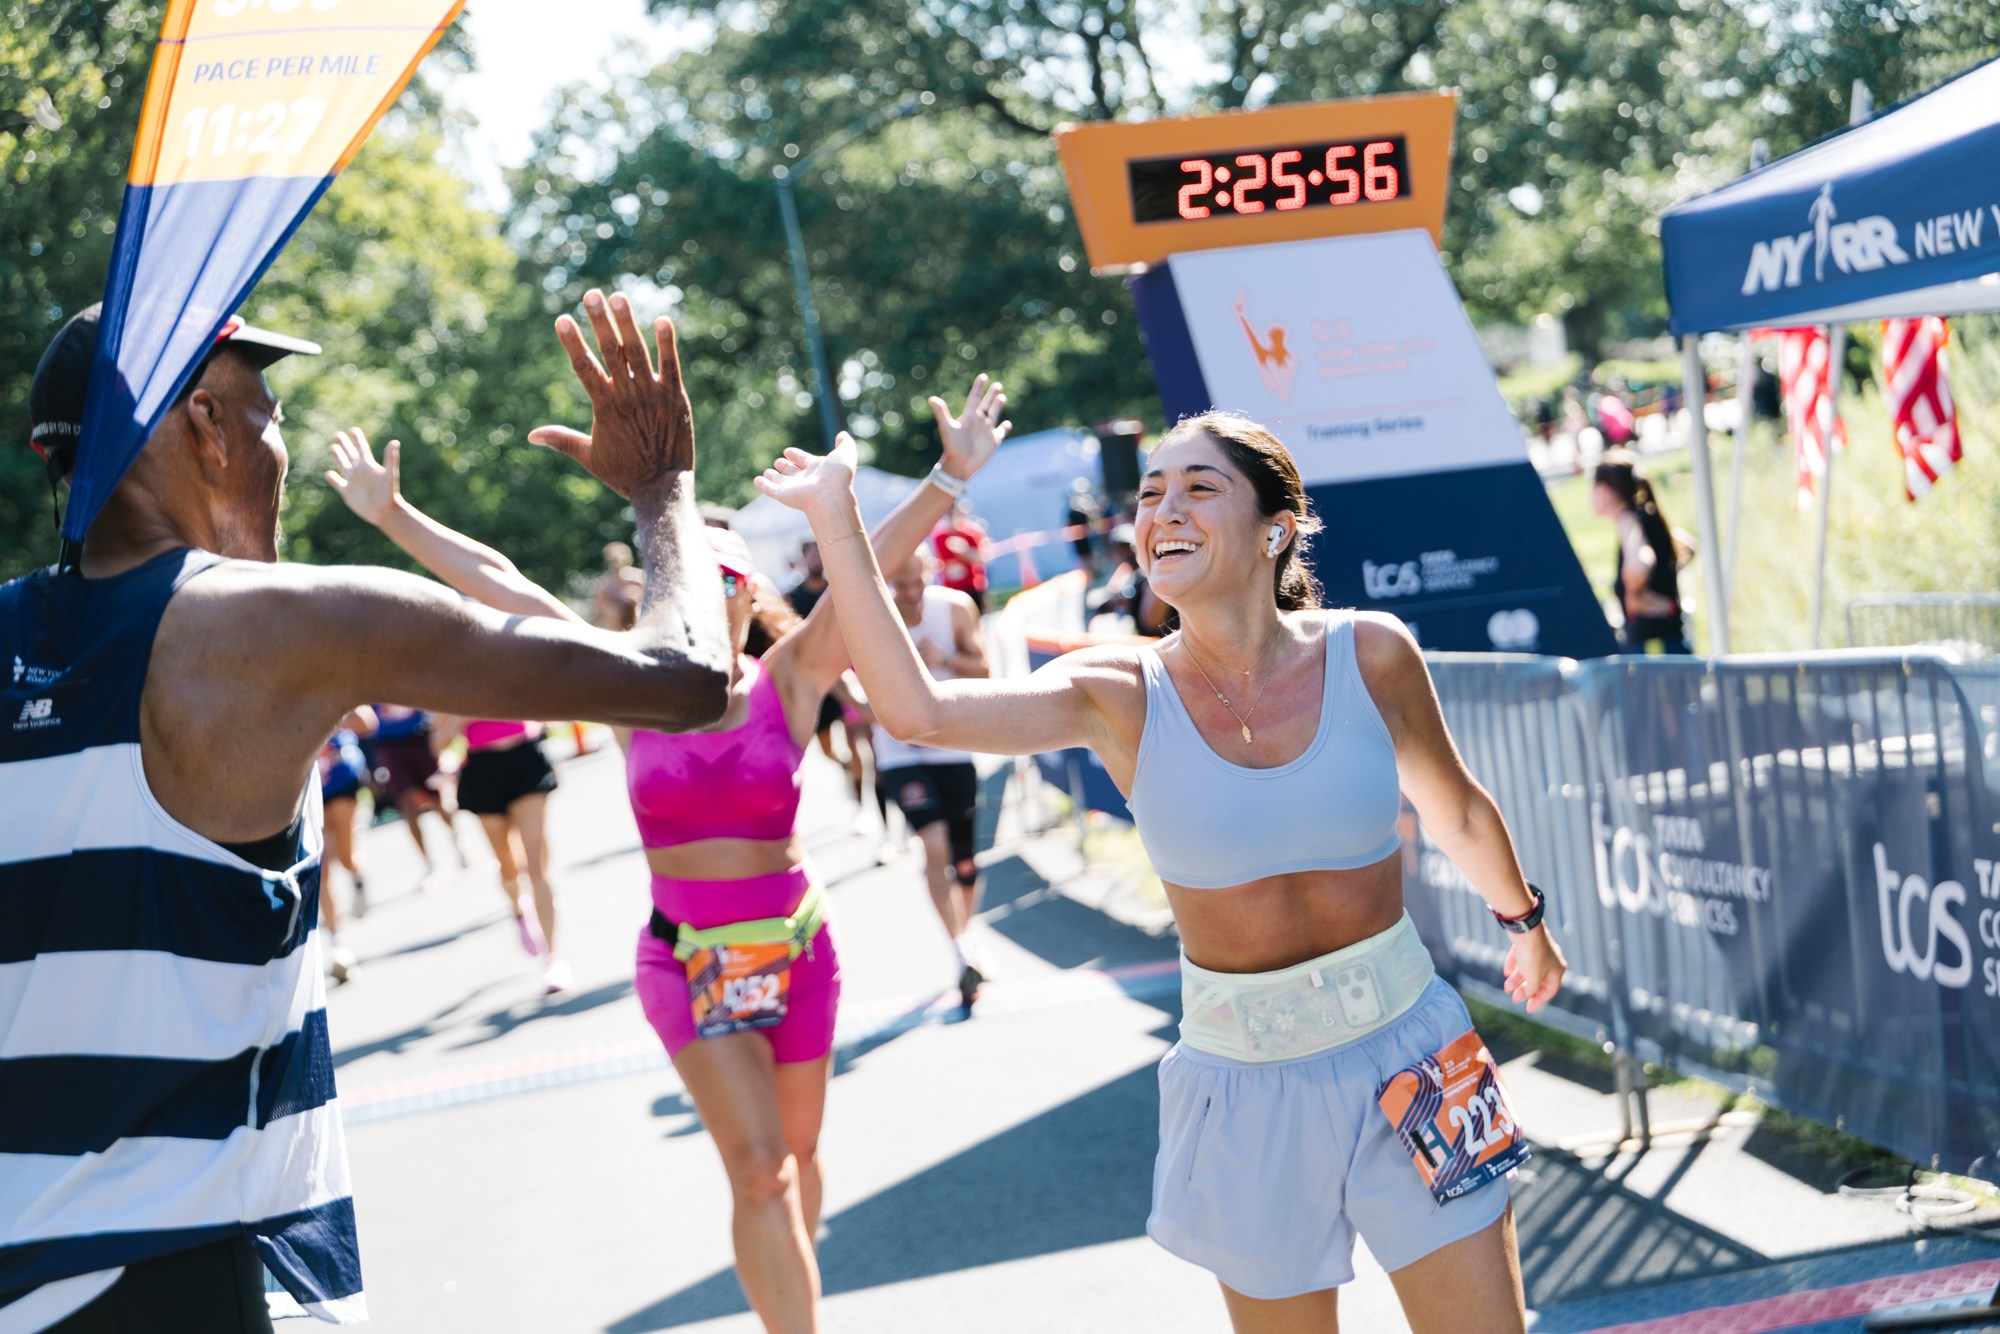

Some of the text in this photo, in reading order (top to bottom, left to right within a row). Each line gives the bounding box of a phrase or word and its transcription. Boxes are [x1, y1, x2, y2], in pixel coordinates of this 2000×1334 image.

[194, 54, 382, 83] PACE PER MILE
[183, 100, 327, 158] 11:27
[1915, 207, 1983, 260] NEW
[1306, 414, 1424, 442] Training Series
[1362, 559, 1422, 599] tcs
[13, 717, 61, 732] new balance
[1652, 814, 1705, 852] TATA
[1873, 842, 1973, 989] tcs
[1446, 1184, 1464, 1198] tcs
